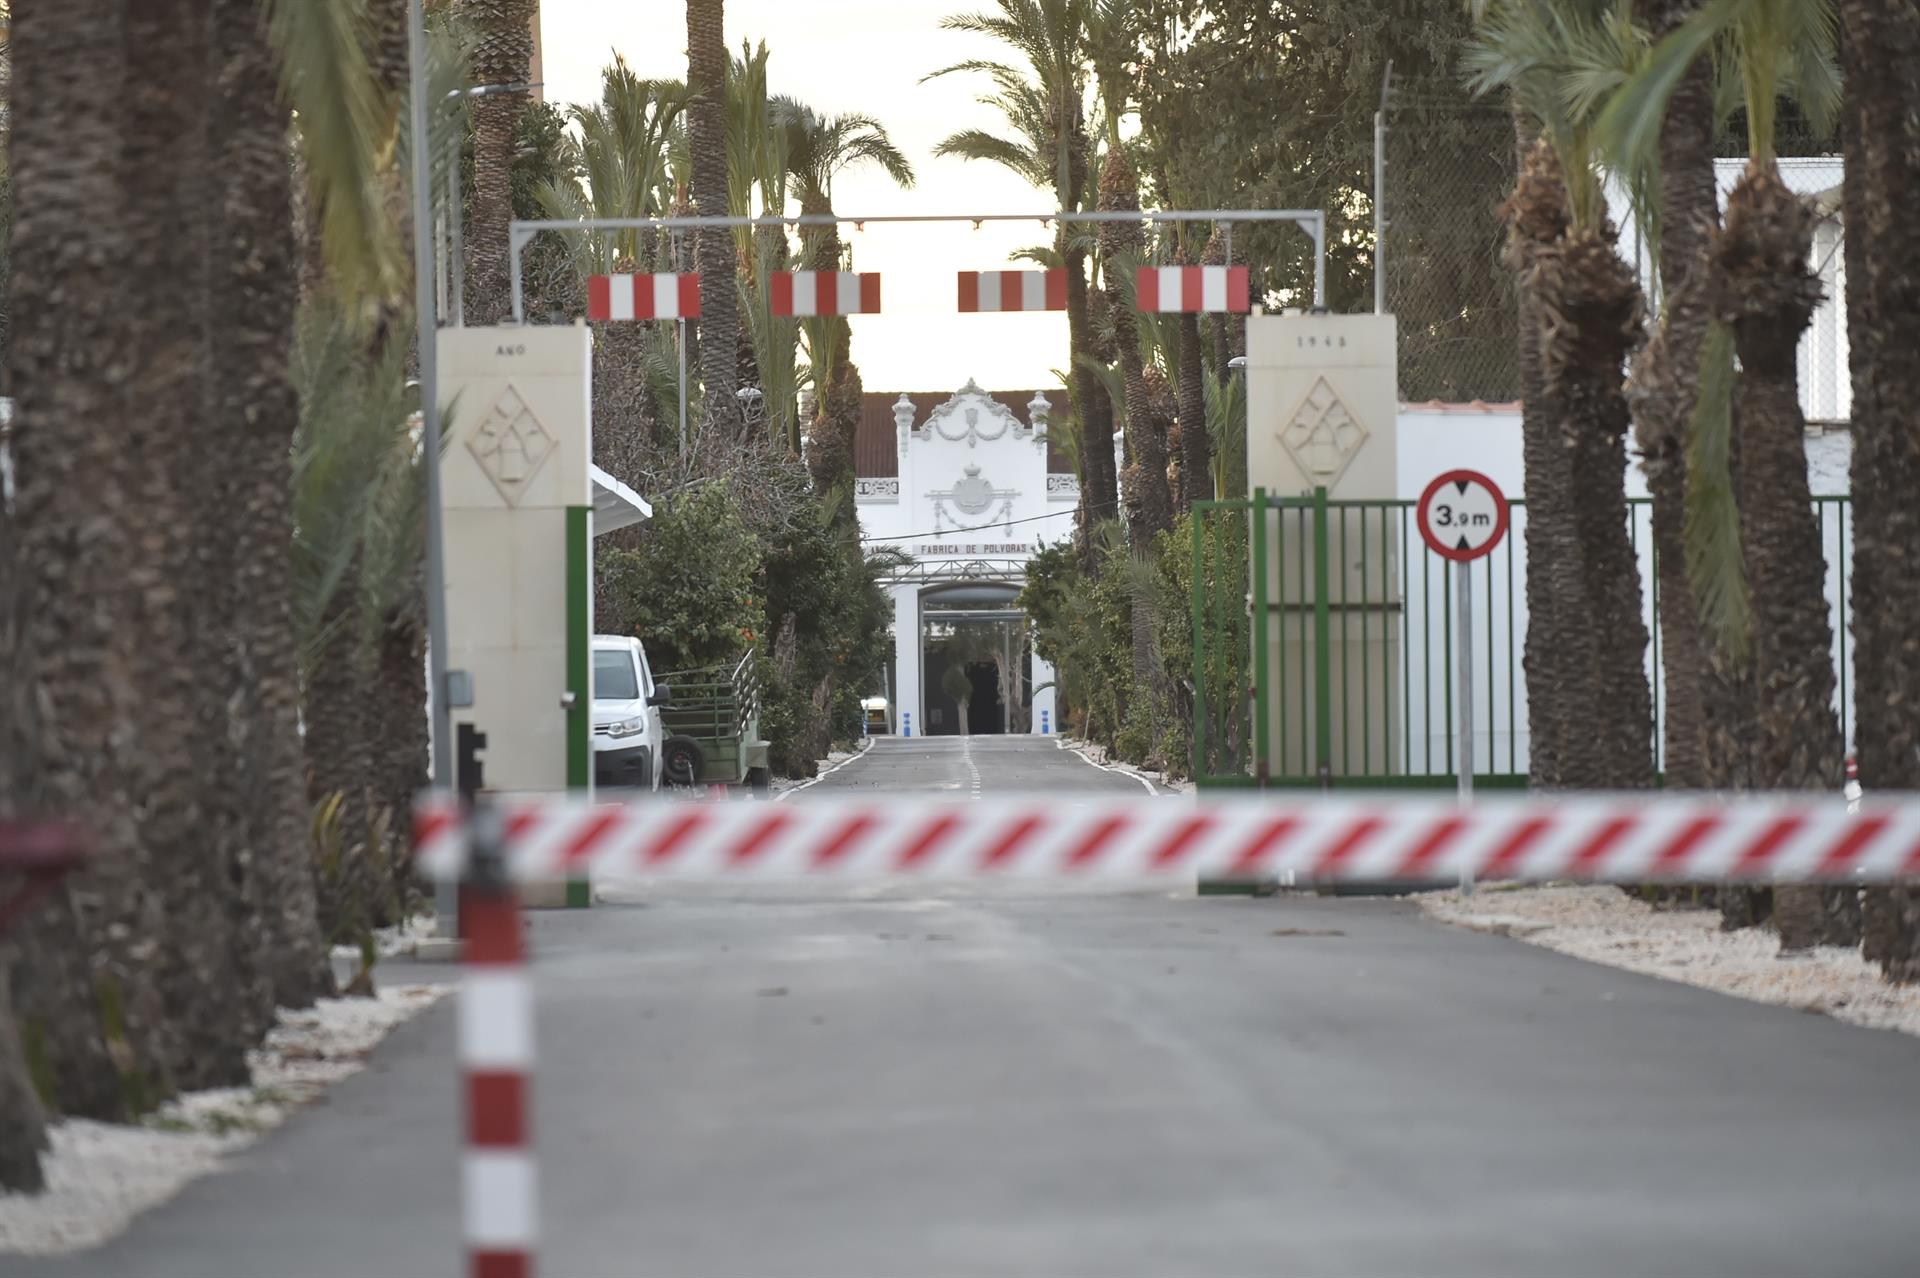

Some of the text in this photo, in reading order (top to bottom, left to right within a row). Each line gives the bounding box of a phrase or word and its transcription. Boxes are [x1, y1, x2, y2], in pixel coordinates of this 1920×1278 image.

[920, 543, 1027, 554] FABRICA DE POLVORAS
